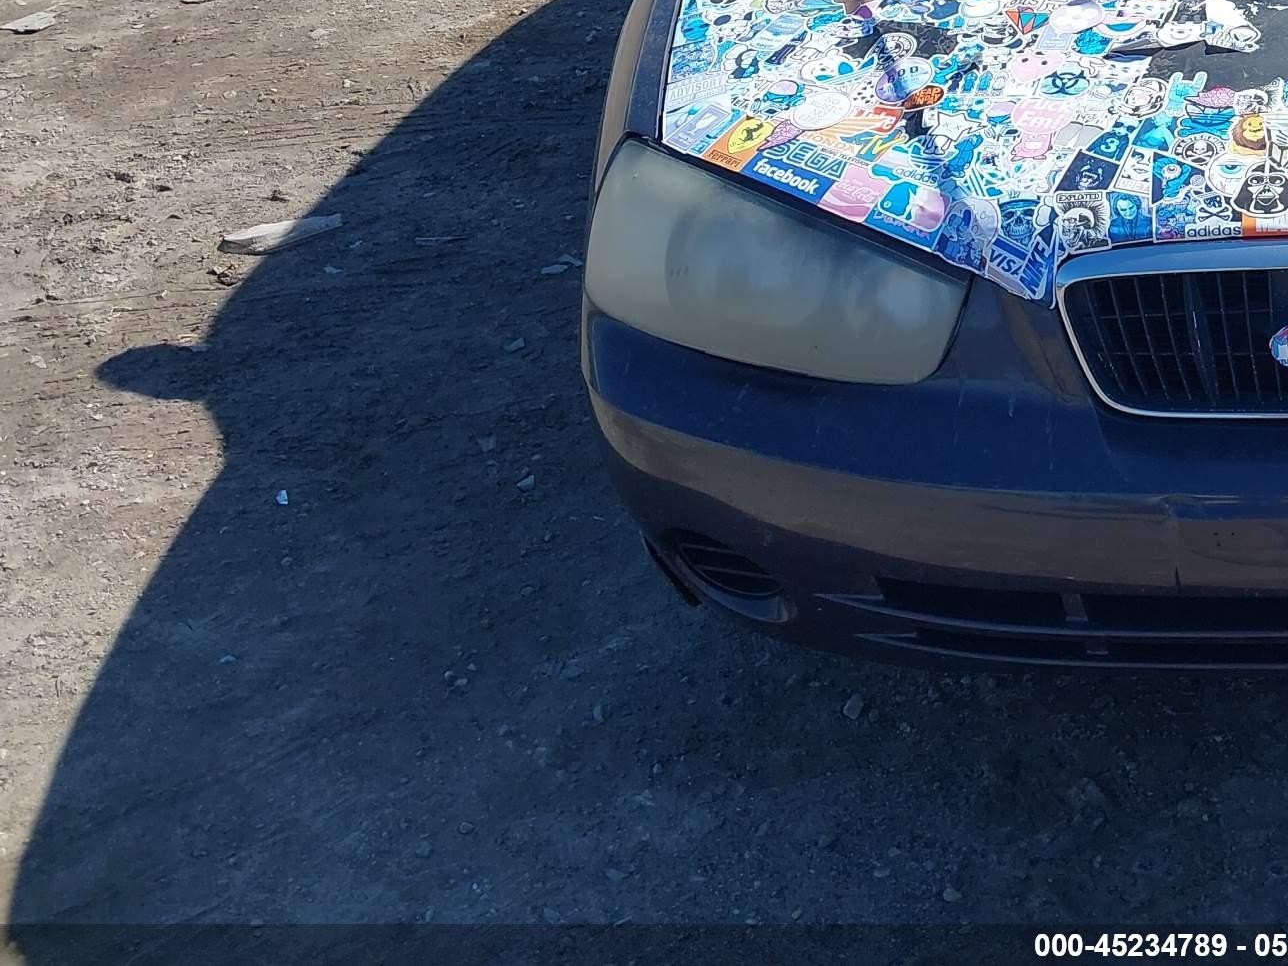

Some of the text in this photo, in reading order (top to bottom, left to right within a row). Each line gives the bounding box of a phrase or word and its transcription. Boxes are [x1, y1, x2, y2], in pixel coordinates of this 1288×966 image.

[1101, 137, 1119, 152] 3
[707, 149, 742, 168] Ferrari
[766, 140, 846, 179] SEGA
[753, 159, 820, 196] facebook
[893, 168, 938, 184] adidas
[1058, 194, 1100, 202] EXPLOITED
[1187, 224, 1242, 238] adidas
[1018, 241, 1050, 296] NIKE
